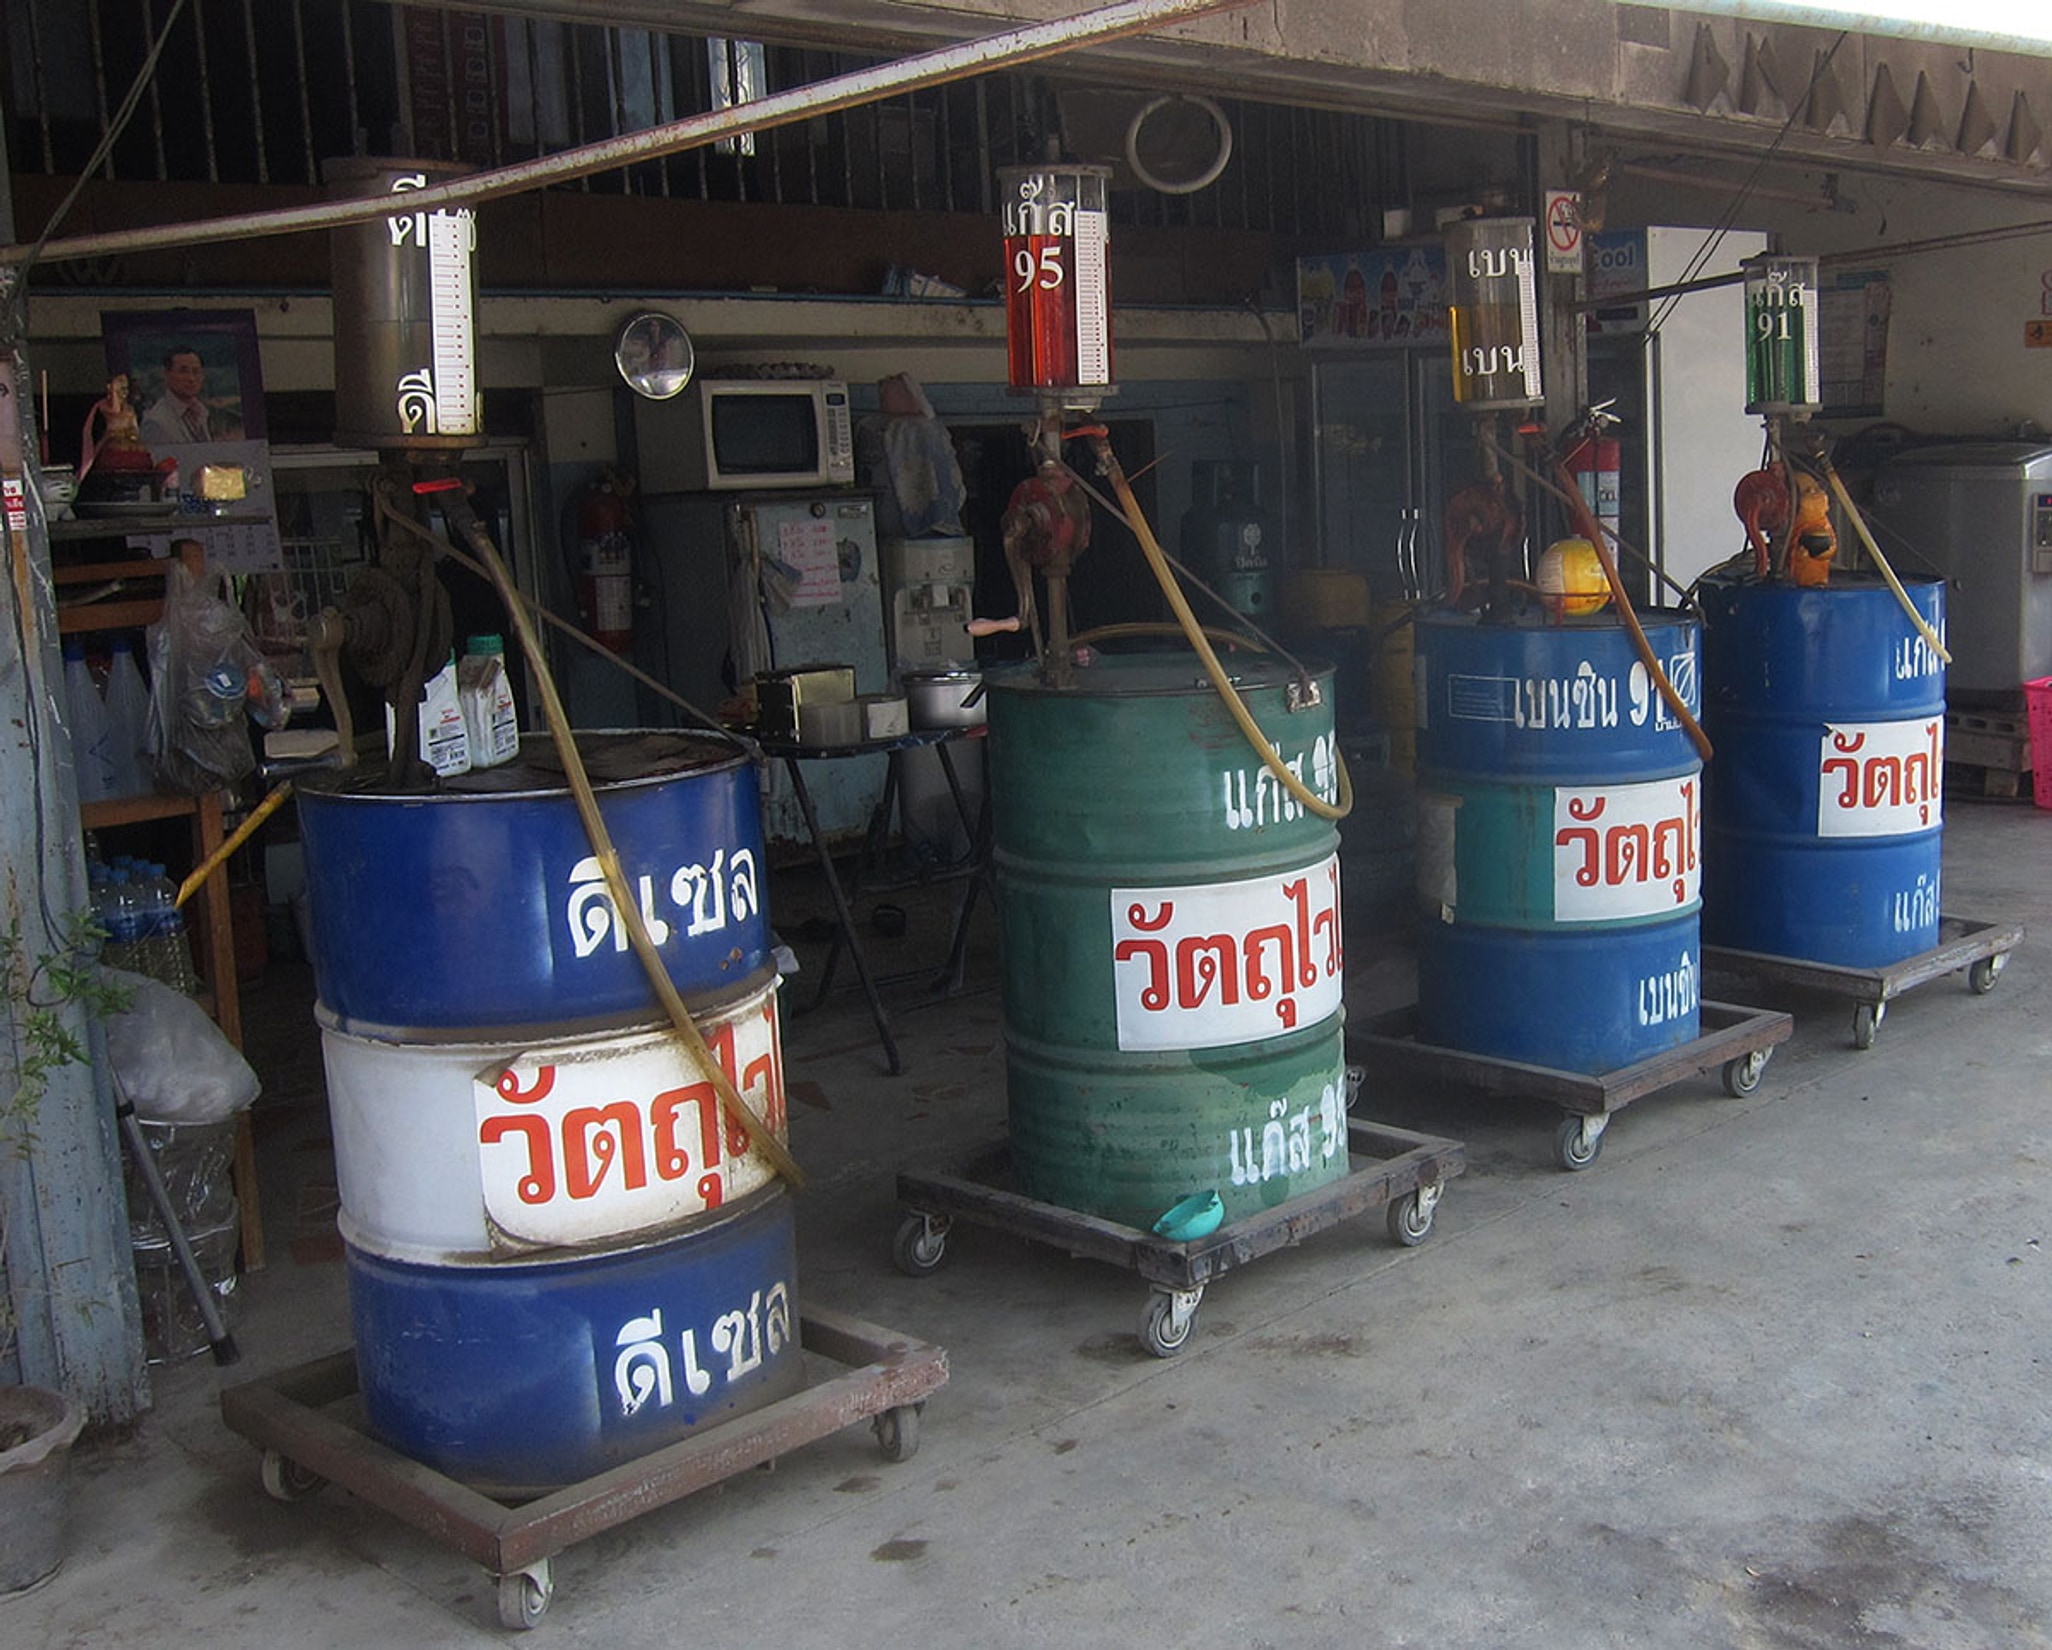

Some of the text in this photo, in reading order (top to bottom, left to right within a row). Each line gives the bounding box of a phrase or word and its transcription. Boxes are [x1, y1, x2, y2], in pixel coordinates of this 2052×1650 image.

[1014, 246, 1064, 294] 95
[1757, 312, 1792, 342] 91
[1555, 780, 1699, 904] วัตถุไ
[614, 1281, 792, 1416] ดีเซล
